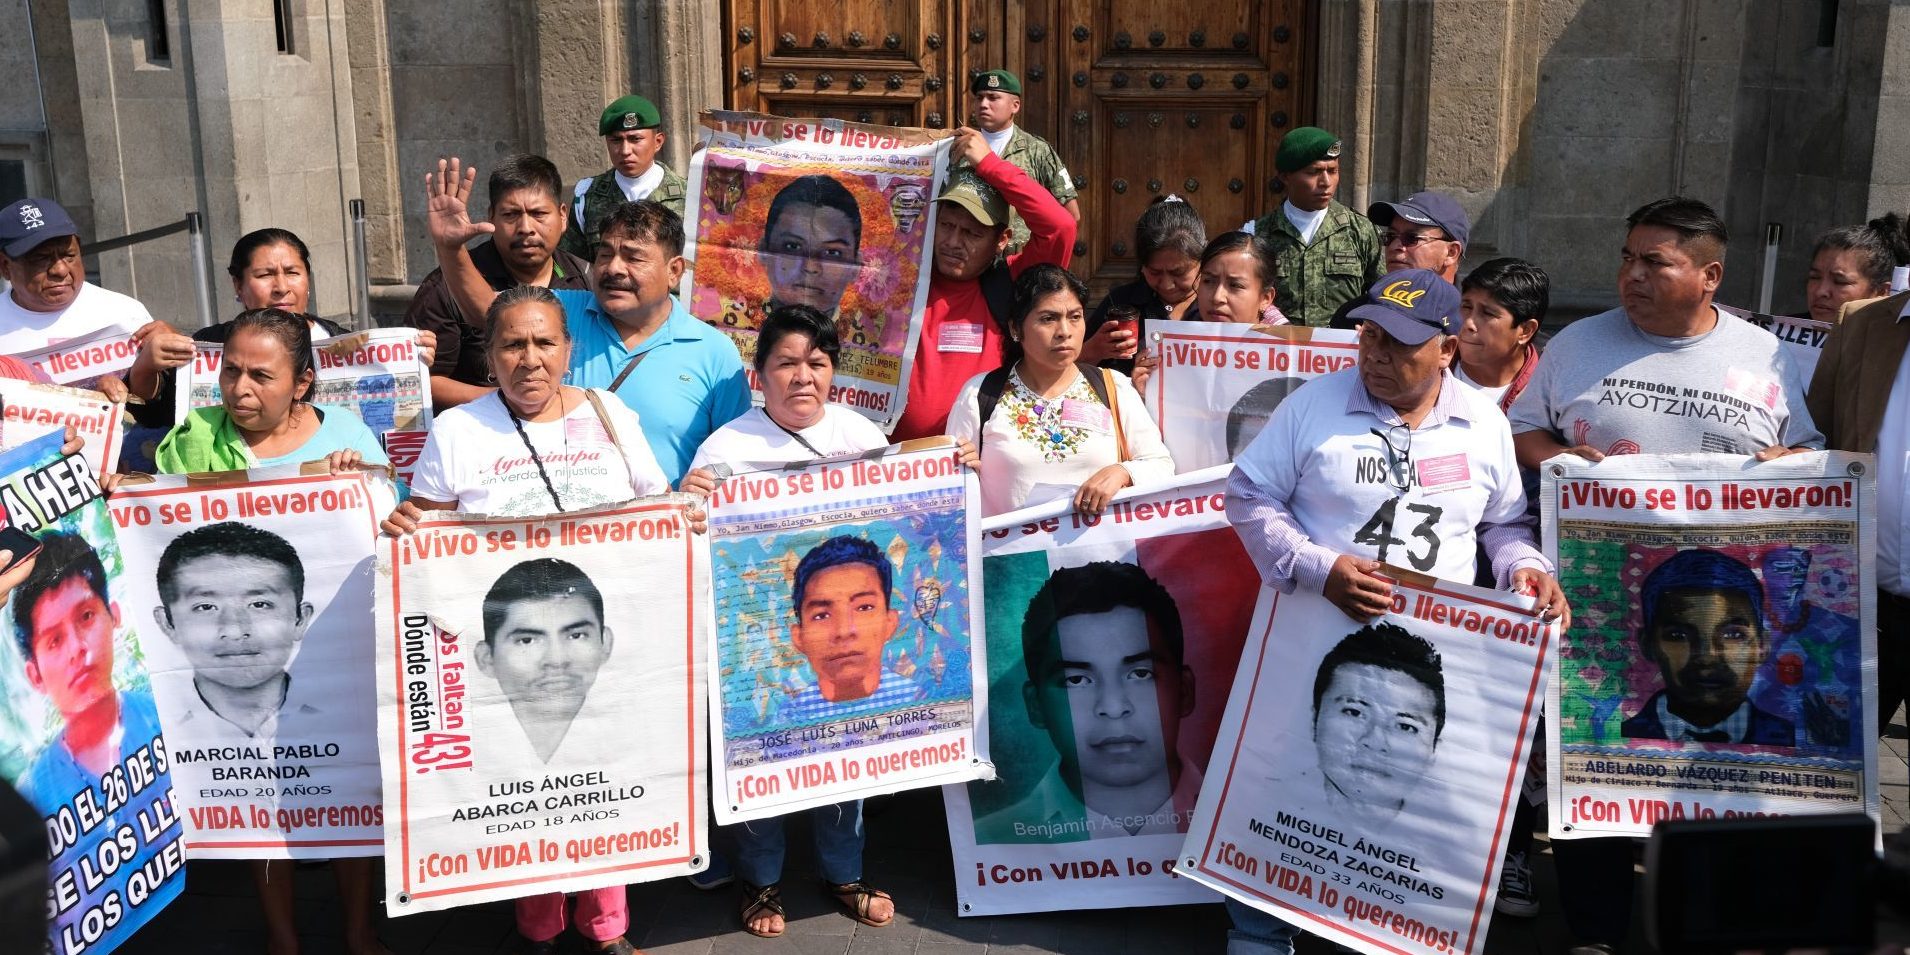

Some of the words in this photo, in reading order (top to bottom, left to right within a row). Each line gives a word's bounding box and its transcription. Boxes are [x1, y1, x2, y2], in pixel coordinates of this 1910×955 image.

[782, 122, 808, 141] se
[813, 122, 836, 145] lo
[840, 127, 918, 150] llevar
[1377, 280, 1426, 308] Cal
[1775, 322, 1829, 350] LLEV
[860, 355, 898, 371] TELUMBRE
[1165, 342, 1228, 369] ¡Vivo
[1233, 349, 1261, 370] se
[1268, 347, 1290, 372] lo
[1297, 349, 1356, 374] lleva
[827, 383, 891, 413] eremos!
[1597, 389, 1752, 432] AYOTZINAPA
[1603, 377, 1617, 387] NI
[1619, 378, 1679, 397] PERDÓN,
[1682, 387, 1698, 399] NI
[1701, 390, 1752, 412] OLVIDO
[4, 404, 105, 434] evaron!
[480, 476, 497, 486] sin
[712, 474, 780, 509] ¡Vivo
[787, 471, 814, 496] se
[821, 465, 844, 491] lo
[851, 450, 961, 488] llevaron!
[1355, 456, 1387, 484] NOS
[24, 453, 104, 525] HER
[159, 501, 192, 525] se
[199, 494, 230, 521] lo
[236, 483, 364, 518] llevaron!
[1560, 480, 1637, 510] ¡Vivo
[1645, 487, 1677, 511] se
[1685, 483, 1713, 511] lo
[1721, 481, 1852, 511] llevaron!
[735, 524, 750, 533] Jan
[860, 506, 888, 518] quiero
[891, 503, 914, 513] saber
[1114, 492, 1226, 524] llevaro
[401, 530, 478, 565] ¡Vivo
[486, 527, 516, 553] se
[525, 523, 551, 549] lo
[560, 514, 681, 547] llevaron!
[1352, 495, 1444, 573] 43
[1413, 594, 1541, 647] llevaron!
[403, 614, 431, 676] Dónde
[439, 629, 460, 657] os
[408, 680, 436, 733] están
[442, 661, 466, 730] faltan
[733, 758, 754, 767] Hijo
[772, 746, 817, 760] Macedonia
[928, 720, 961, 732] MORELOS
[758, 731, 792, 750] JOSÉ
[844, 719, 879, 735] LUNA
[886, 708, 937, 727] TORRES
[175, 746, 269, 764] MARCIAL
[272, 742, 340, 760] PABLO
[411, 732, 474, 775] 43!
[73, 785, 104, 835] EL
[100, 764, 129, 815] 26
[125, 744, 156, 797] DE
[151, 733, 168, 776] S
[212, 765, 311, 781] BARANDA
[489, 780, 535, 798] LUIS
[540, 770, 610, 792] ÁNGEL
[736, 773, 781, 804] ¡Con
[785, 760, 837, 791] VIDA
[841, 756, 860, 781] lo
[866, 737, 967, 781] queremos!
[1585, 760, 1667, 778] ABELARDO
[1675, 763, 1749, 783] VÁZQUEZ
[1759, 770, 1836, 789] PENITEN
[199, 787, 248, 799] EDAD
[255, 786, 275, 797] 20
[281, 784, 333, 797] AÑOS
[451, 799, 539, 822] ABARCA
[544, 784, 645, 810] CARRILLO
[1813, 791, 1860, 802] Guerrero
[188, 805, 246, 831] VIDA
[250, 804, 270, 829] lo
[486, 819, 536, 835] EDAD
[543, 815, 564, 827] 18
[570, 808, 620, 824] AÑOS
[1013, 815, 1097, 839] Benjamín
[1100, 811, 1182, 831] Ascencio
[1571, 795, 1621, 824] ¡Con
[1627, 798, 1688, 826] VIDA
[418, 852, 468, 884] ¡Con
[476, 841, 533, 872] VIDA
[539, 838, 559, 863] lo
[566, 821, 680, 864] queremos!
[1276, 810, 1349, 849] MIGUEL
[1353, 837, 1421, 873] ÁNGEL
[79, 825, 138, 893] LOS
[975, 862, 1043, 887] ¡Con
[1049, 858, 1120, 880] VIDA
[1126, 857, 1153, 877] lo
[1248, 818, 1340, 865] MENDOZA
[1344, 855, 1445, 900] ZACARIAS
[1280, 852, 1327, 876] EDAD
[1332, 870, 1352, 886] 33
[1356, 878, 1406, 905] AÑOS
[1215, 841, 1258, 877] ¡Con
[1265, 860, 1313, 900] VIDA
[1318, 881, 1339, 909] lo
[1343, 895, 1459, 955] queremos!
[61, 890, 124, 955] LOS
